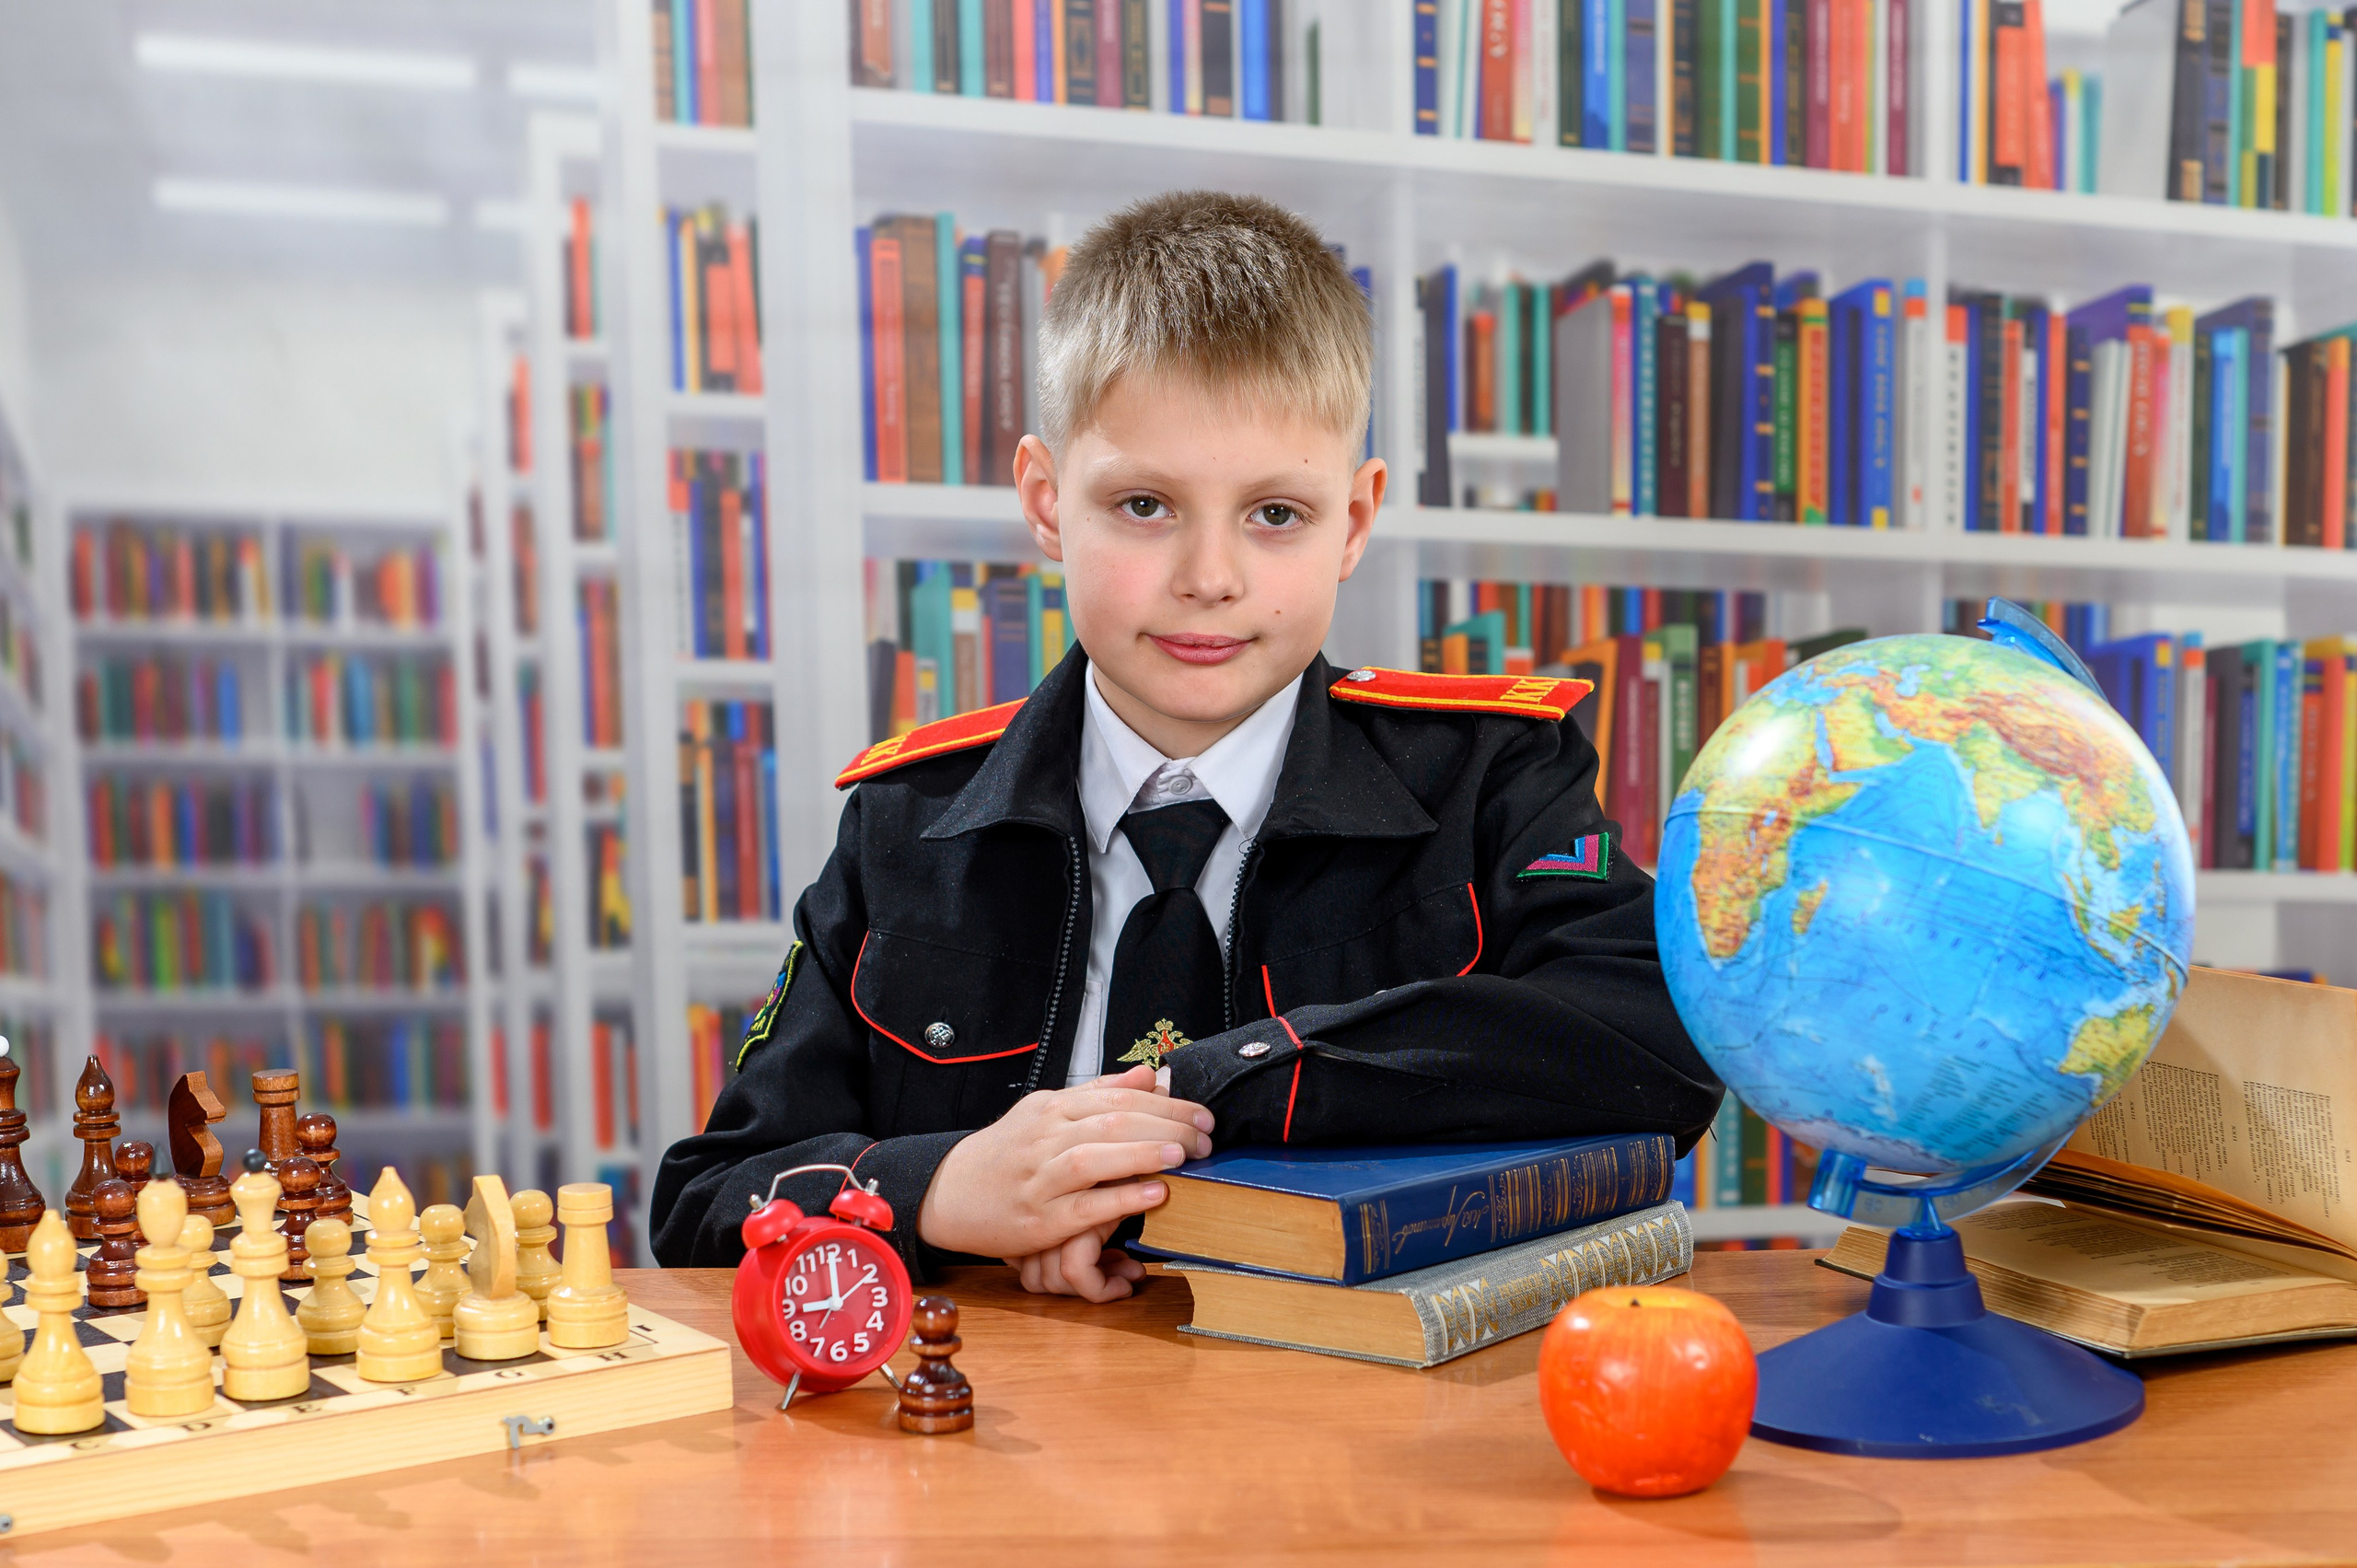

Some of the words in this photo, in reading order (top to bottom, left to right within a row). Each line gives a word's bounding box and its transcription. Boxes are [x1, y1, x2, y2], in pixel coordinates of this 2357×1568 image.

[796, 1253, 818, 1273] 11
[816, 1243, 842, 1264] 12
[847, 1249, 858, 1269] 1
[863, 1263, 878, 1284] 2
[784, 1275, 808, 1296] 10
[871, 1286, 888, 1307] 3
[782, 1299, 796, 1320] 9
[788, 1320, 807, 1342] 8
[865, 1310, 885, 1332] 4
[809, 1337, 826, 1357] 7
[830, 1341, 848, 1362] 6
[853, 1331, 870, 1353] 5
[69, 1439, 100, 1451] C
[180, 1422, 212, 1433] D
[291, 1403, 321, 1414] E
[396, 1386, 416, 1397] F
[494, 1368, 526, 1379] G
[595, 1351, 633, 1363] H
